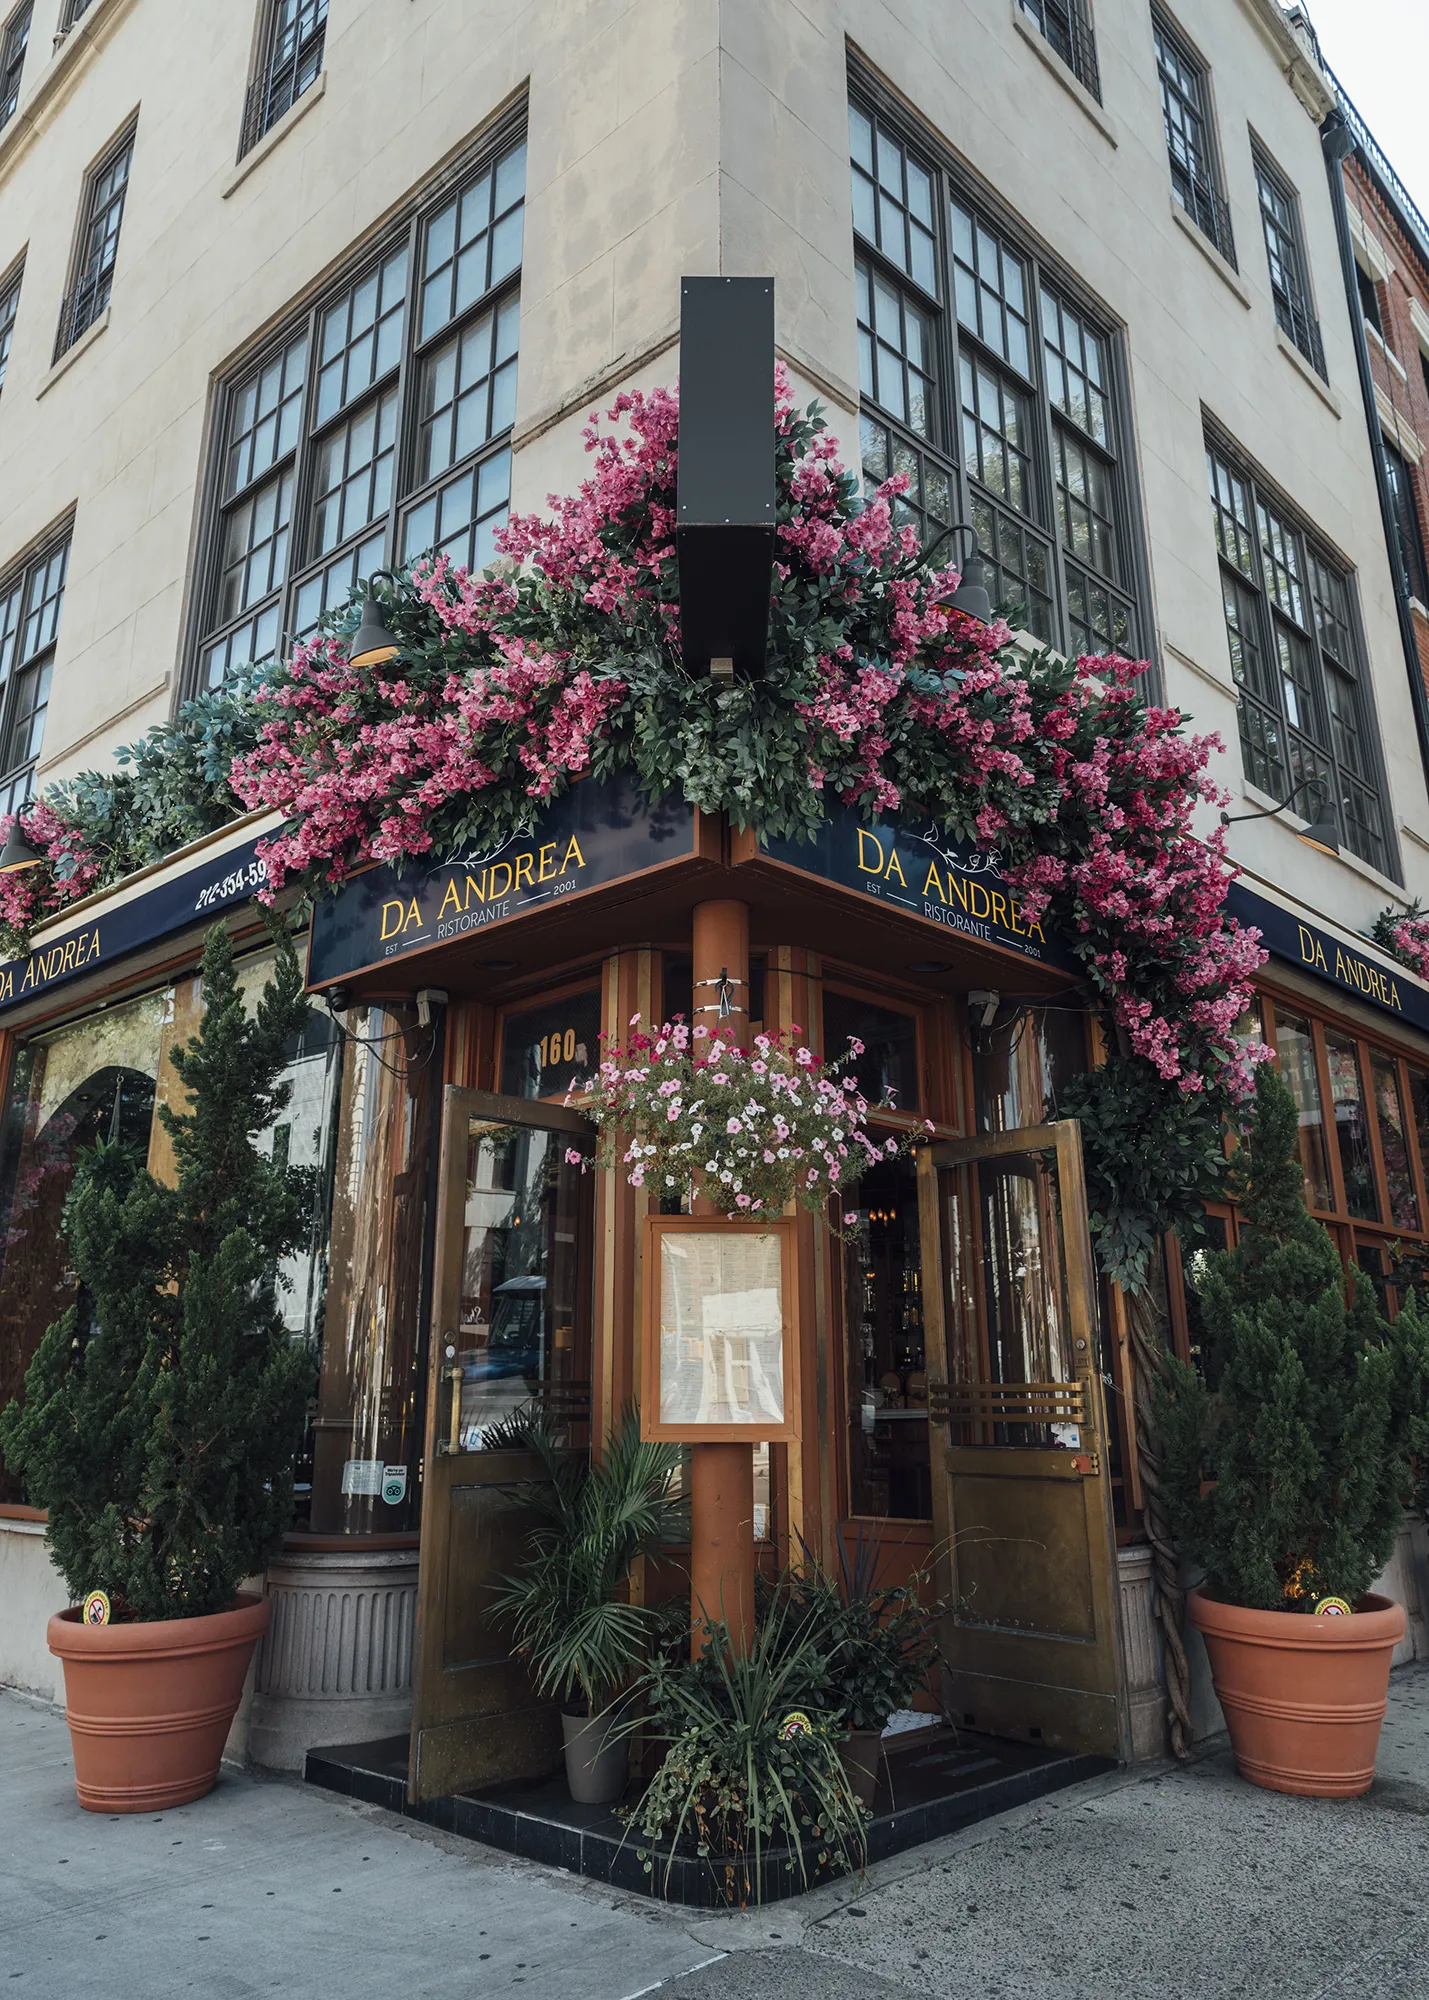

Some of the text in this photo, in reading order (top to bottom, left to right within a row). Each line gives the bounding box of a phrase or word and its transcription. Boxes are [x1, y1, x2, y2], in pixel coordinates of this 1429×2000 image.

[379, 834, 586, 941] DA ANDREA
[385, 879, 577, 956] EST RISTORANTE 2001
[856, 827, 1047, 944] DA ANDREA
[866, 881, 1041, 959] EST RISTORANTE 2001
[20, 928, 101, 993] ANDREA
[1298, 925, 1402, 1011] DA ANDREA
[540, 1028, 576, 1068] 160
